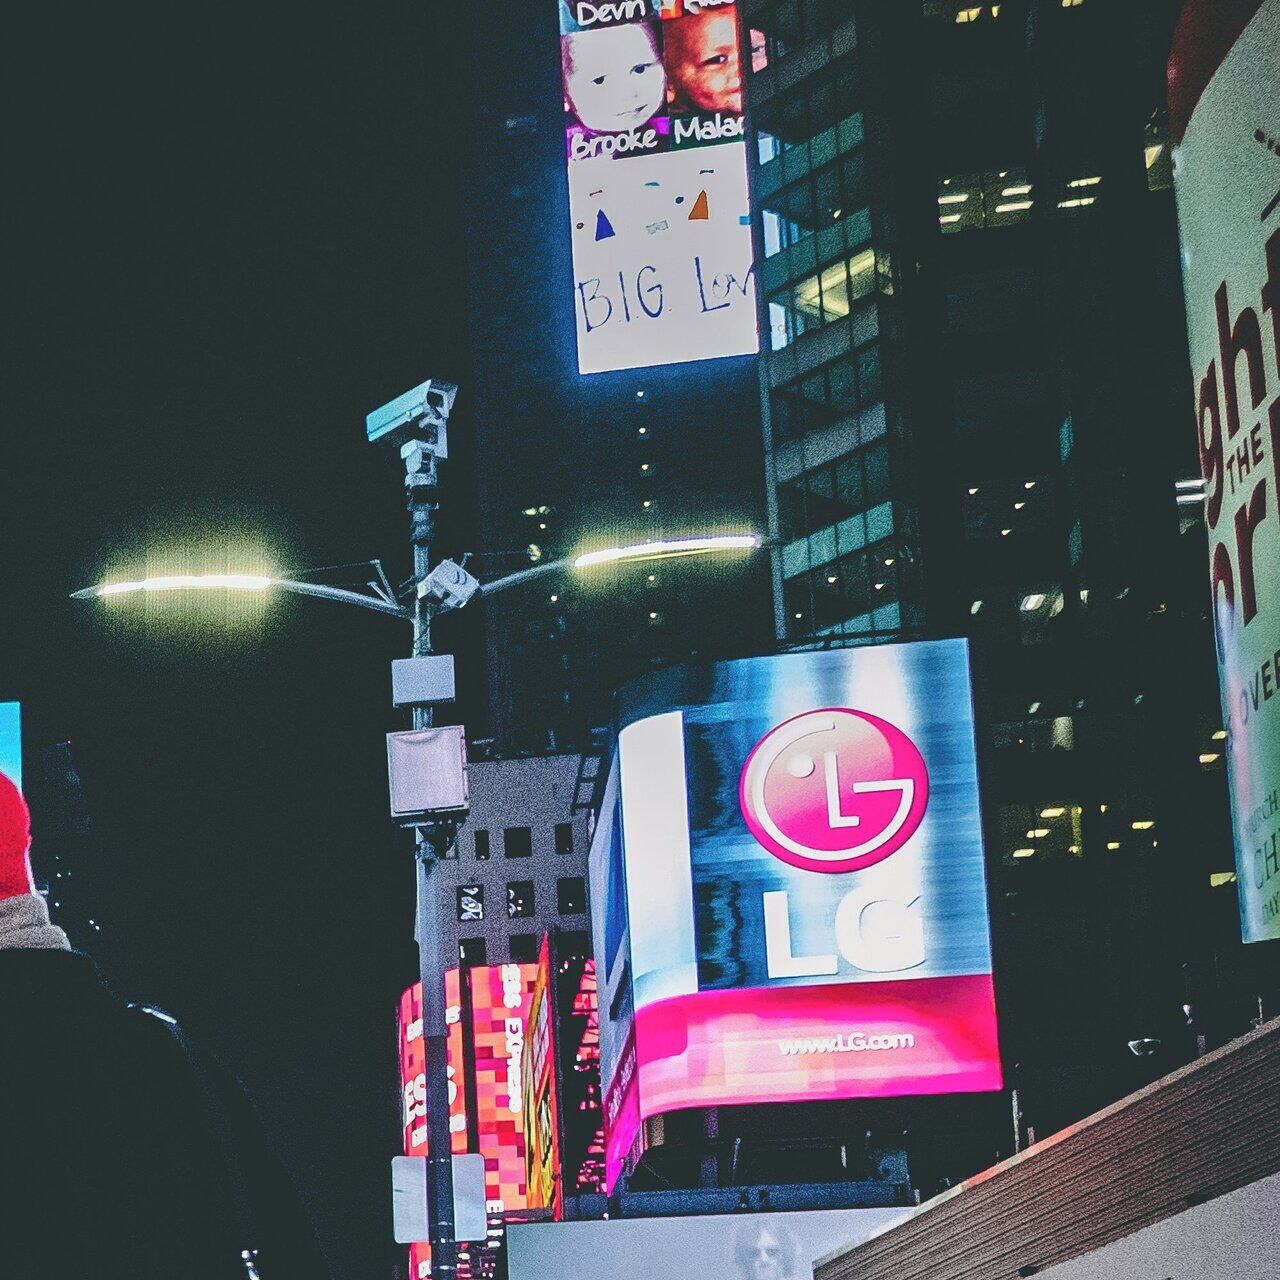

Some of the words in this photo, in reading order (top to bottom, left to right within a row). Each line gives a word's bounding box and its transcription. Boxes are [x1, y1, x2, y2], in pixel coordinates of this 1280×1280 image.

[570, 128, 659, 160] Brooke
[763, 882, 925, 979] LG
[779, 1030, 915, 1056] www.LG.com
